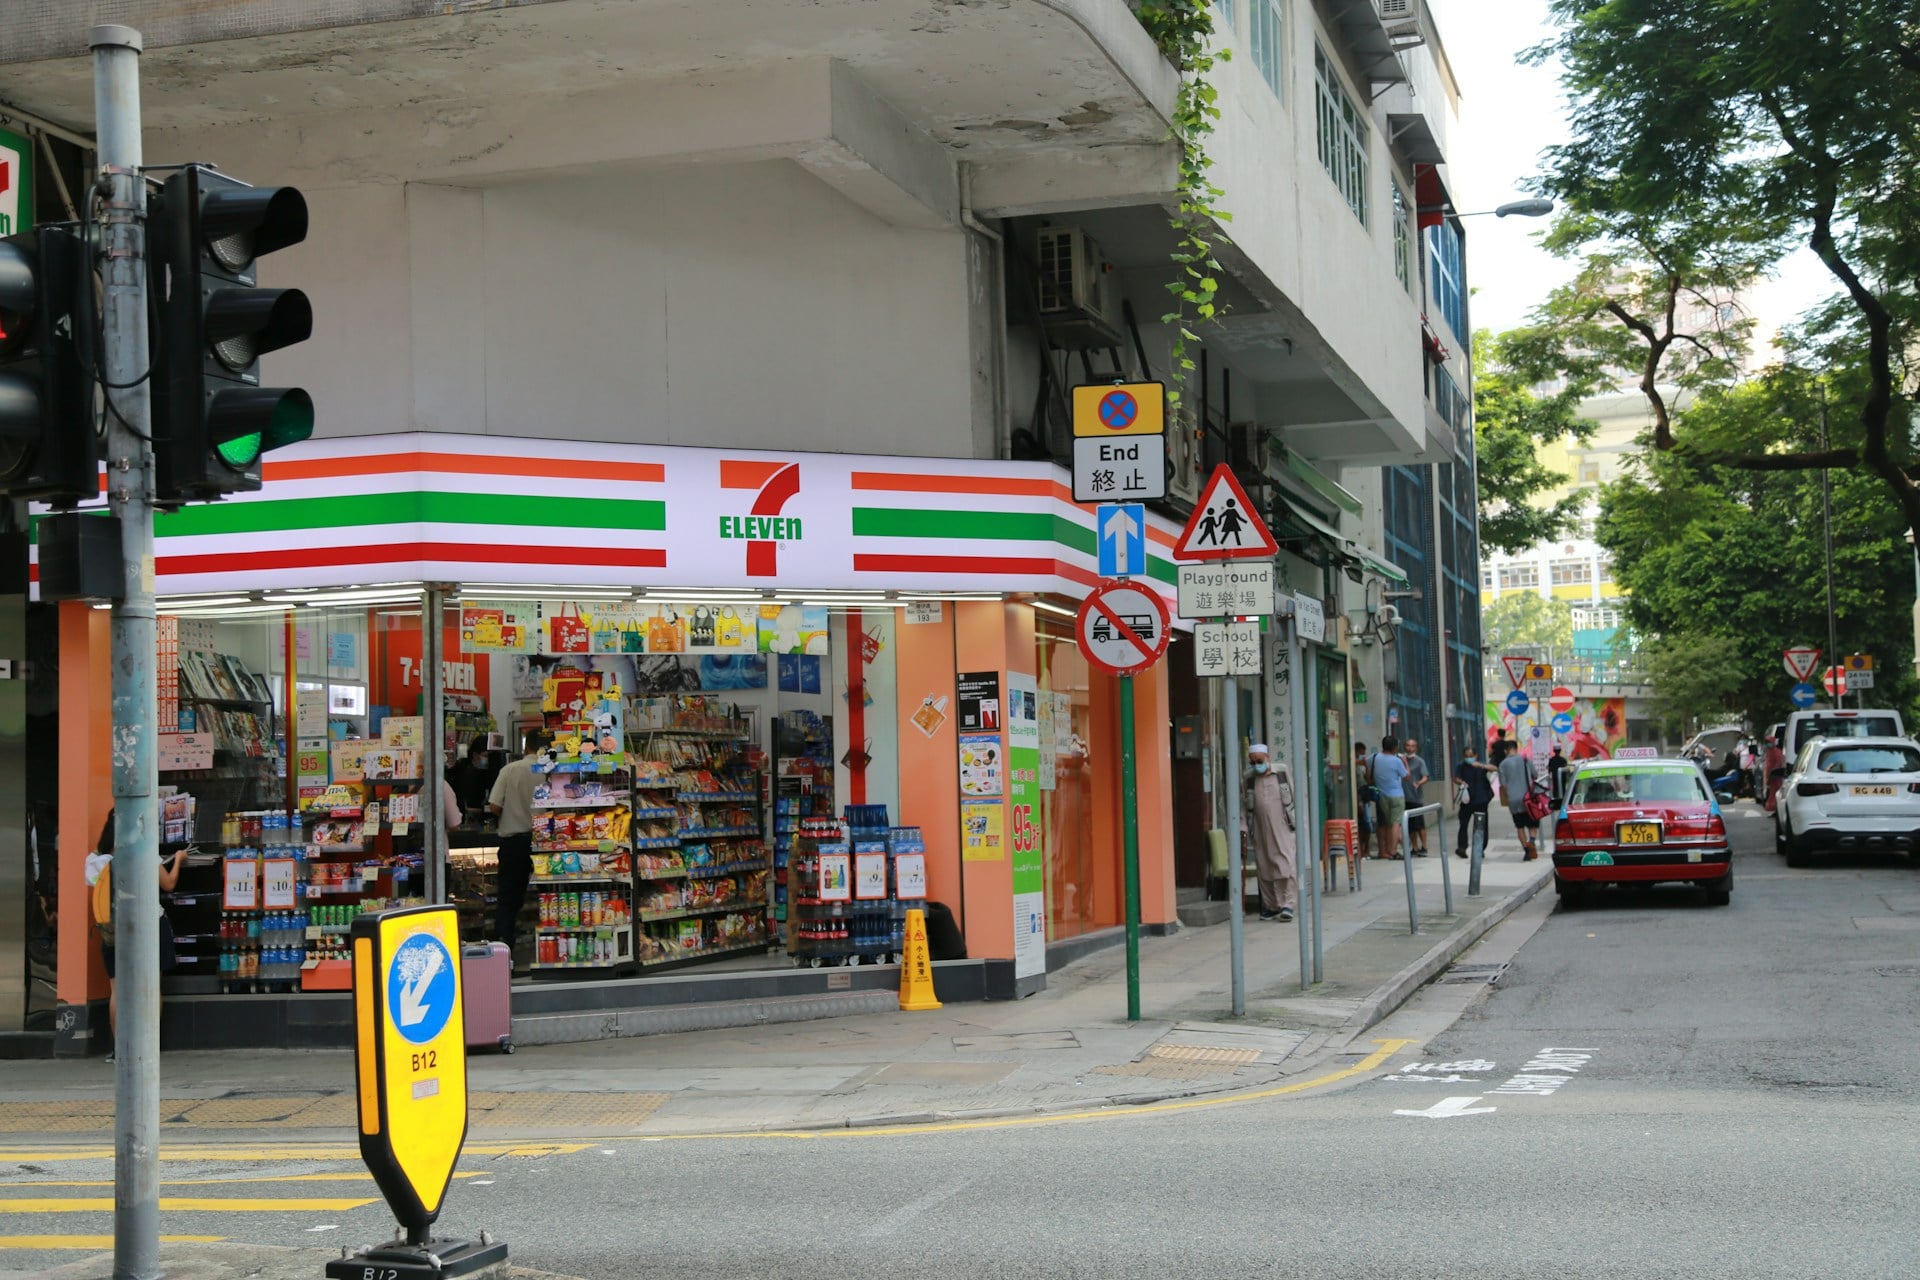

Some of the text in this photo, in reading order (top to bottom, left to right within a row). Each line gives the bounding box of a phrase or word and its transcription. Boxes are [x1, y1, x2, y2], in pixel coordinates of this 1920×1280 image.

[1099, 443, 1139, 461] End
[1091, 468, 1147, 493] 終止
[719, 459, 801, 577] 7
[1183, 570, 1268, 587] Playground
[1195, 590, 1257, 609] 遊樂場
[917, 614, 930, 622] 193
[1201, 629, 1254, 643] School
[1201, 646, 1258, 669] 學校
[1616, 748, 1655, 758] TAXI
[1854, 786, 1868, 795] RG
[1631, 823, 1648, 834] KC
[1626, 833, 1654, 844] 3718
[411, 1050, 438, 1073] B12
[1520, 1047, 1601, 1073] LOOK
